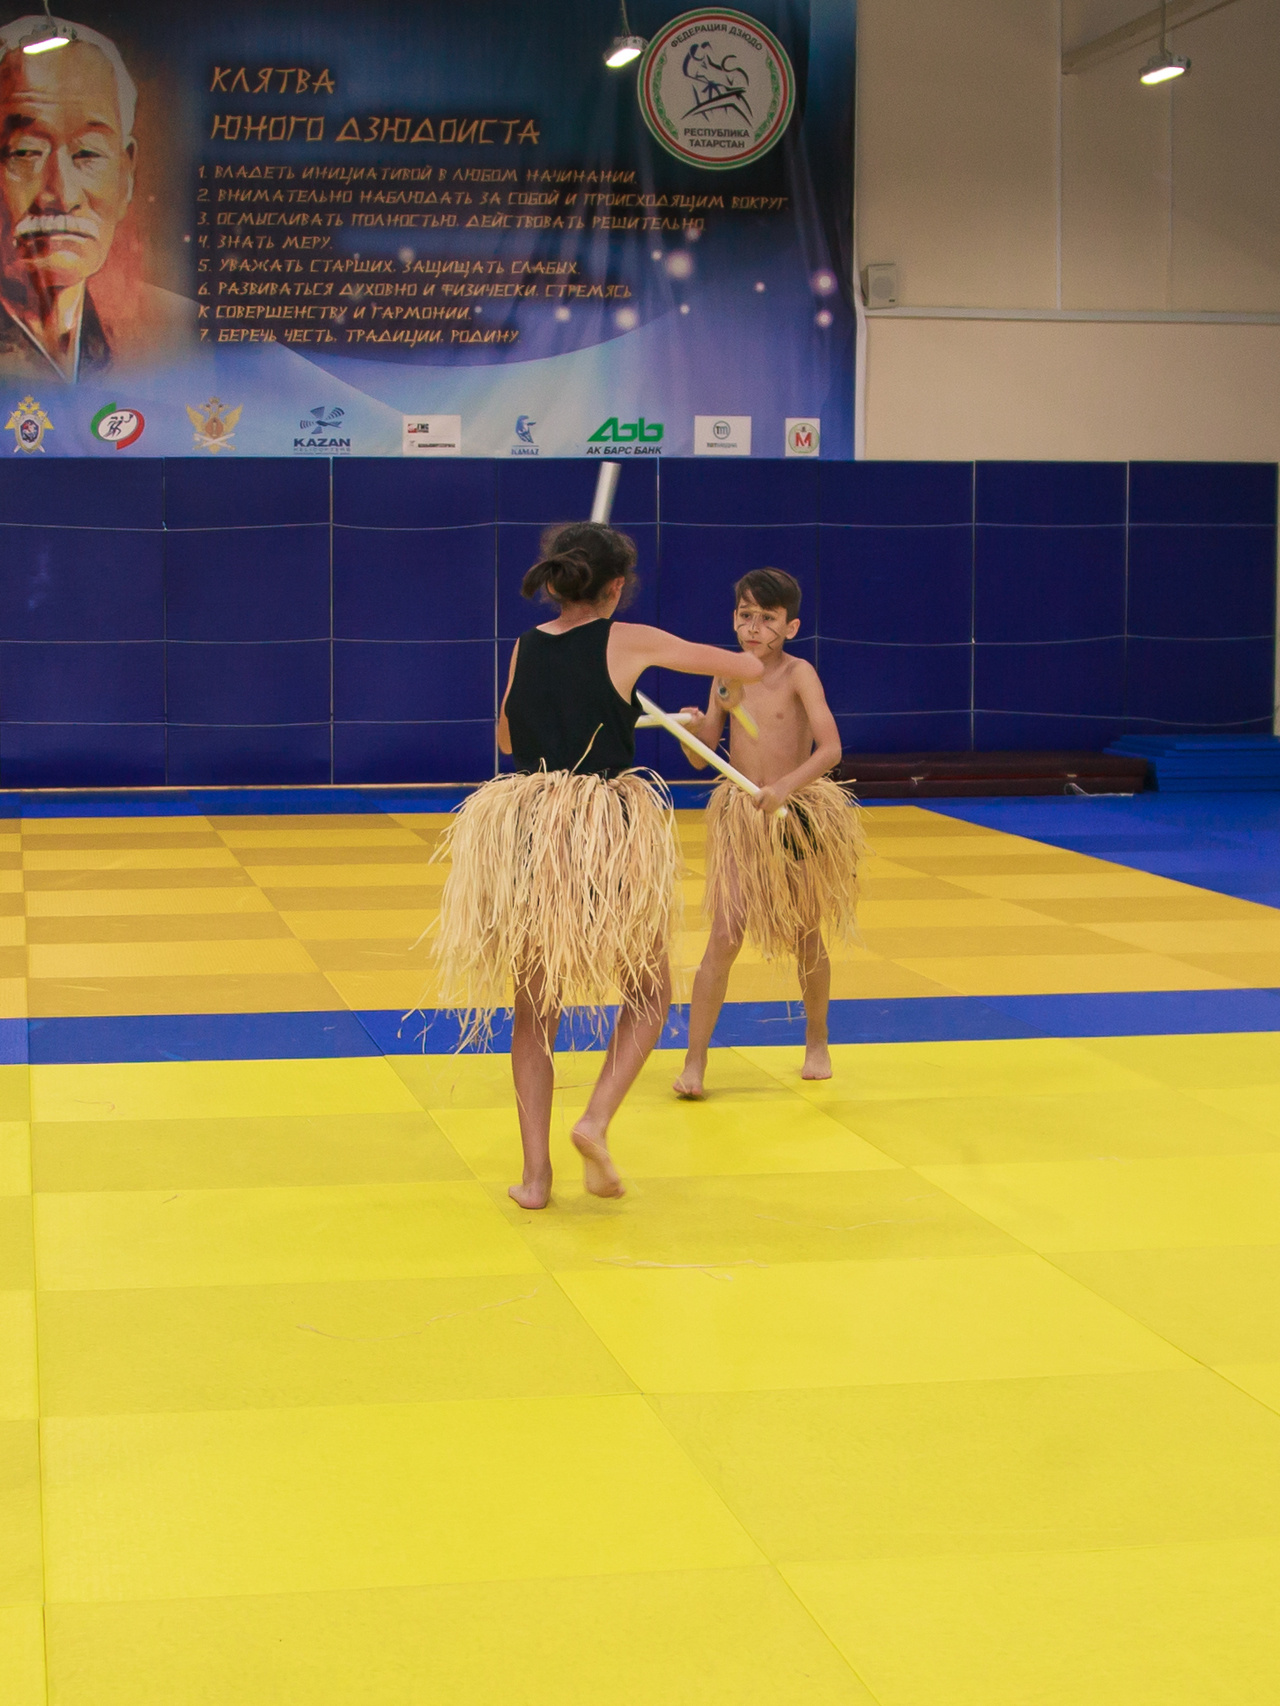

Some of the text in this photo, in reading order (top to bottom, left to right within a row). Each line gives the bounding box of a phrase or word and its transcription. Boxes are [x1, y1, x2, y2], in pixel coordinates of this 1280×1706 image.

[671, 24, 762, 50] ФЕДЕРАЦИЯ ДЗЮДО
[210, 66, 335, 94] КЛЯТВА
[211, 115, 540, 144] ЮНОГО ДЗЮДОИСТА
[684, 128, 750, 138] РЕСПУБЛИКА
[689, 139, 745, 148] ТАТАРСТАН
[198, 166, 207, 180] 1.
[214, 165, 295, 180] ВЛАДЕТЬ
[301, 165, 432, 185] ИНИЦИАТИВОЙ
[438, 168, 447, 181] В
[452, 168, 517, 182] ЛЮБОМ
[218, 188, 352, 203] ВНИМАТЕЛЬНО
[360, 190, 472, 204] НАБЛЮДАТЬ
[480, 191, 501, 206] ЗА
[508, 189, 559, 206] СОБОЙ
[565, 193, 576, 206] И
[584, 193, 724, 212] ПРОИСХОДЯЩИМ
[217, 212, 344, 227] ОСМЫСЛИВАТЬ
[465, 211, 585, 229] ДЕЙСТВОВАТЬ
[217, 235, 274, 249] ЗНАТЬ
[282, 236, 333, 250] МЕРУ.
[219, 258, 304, 273] УВАЖАТЬ
[402, 259, 504, 278] ЗАЩИЩАТЬ
[511, 260, 580, 275] СЛАБЫХ.
[218, 282, 334, 296] РАЗВИВАТЬСЯ
[339, 282, 418, 296] ДУХОВНО
[423, 283, 436, 296] И
[545, 284, 632, 298] СТРЕМЯСЬ
[198, 305, 472, 320] К СОВЕРШЕНСТВУ И ГАРМОНИИ.
[218, 328, 277, 343] БЕРЕЧЬ
[294, 438, 351, 447] KAZAN
[586, 446, 663, 455] АК БАРС БАНК
